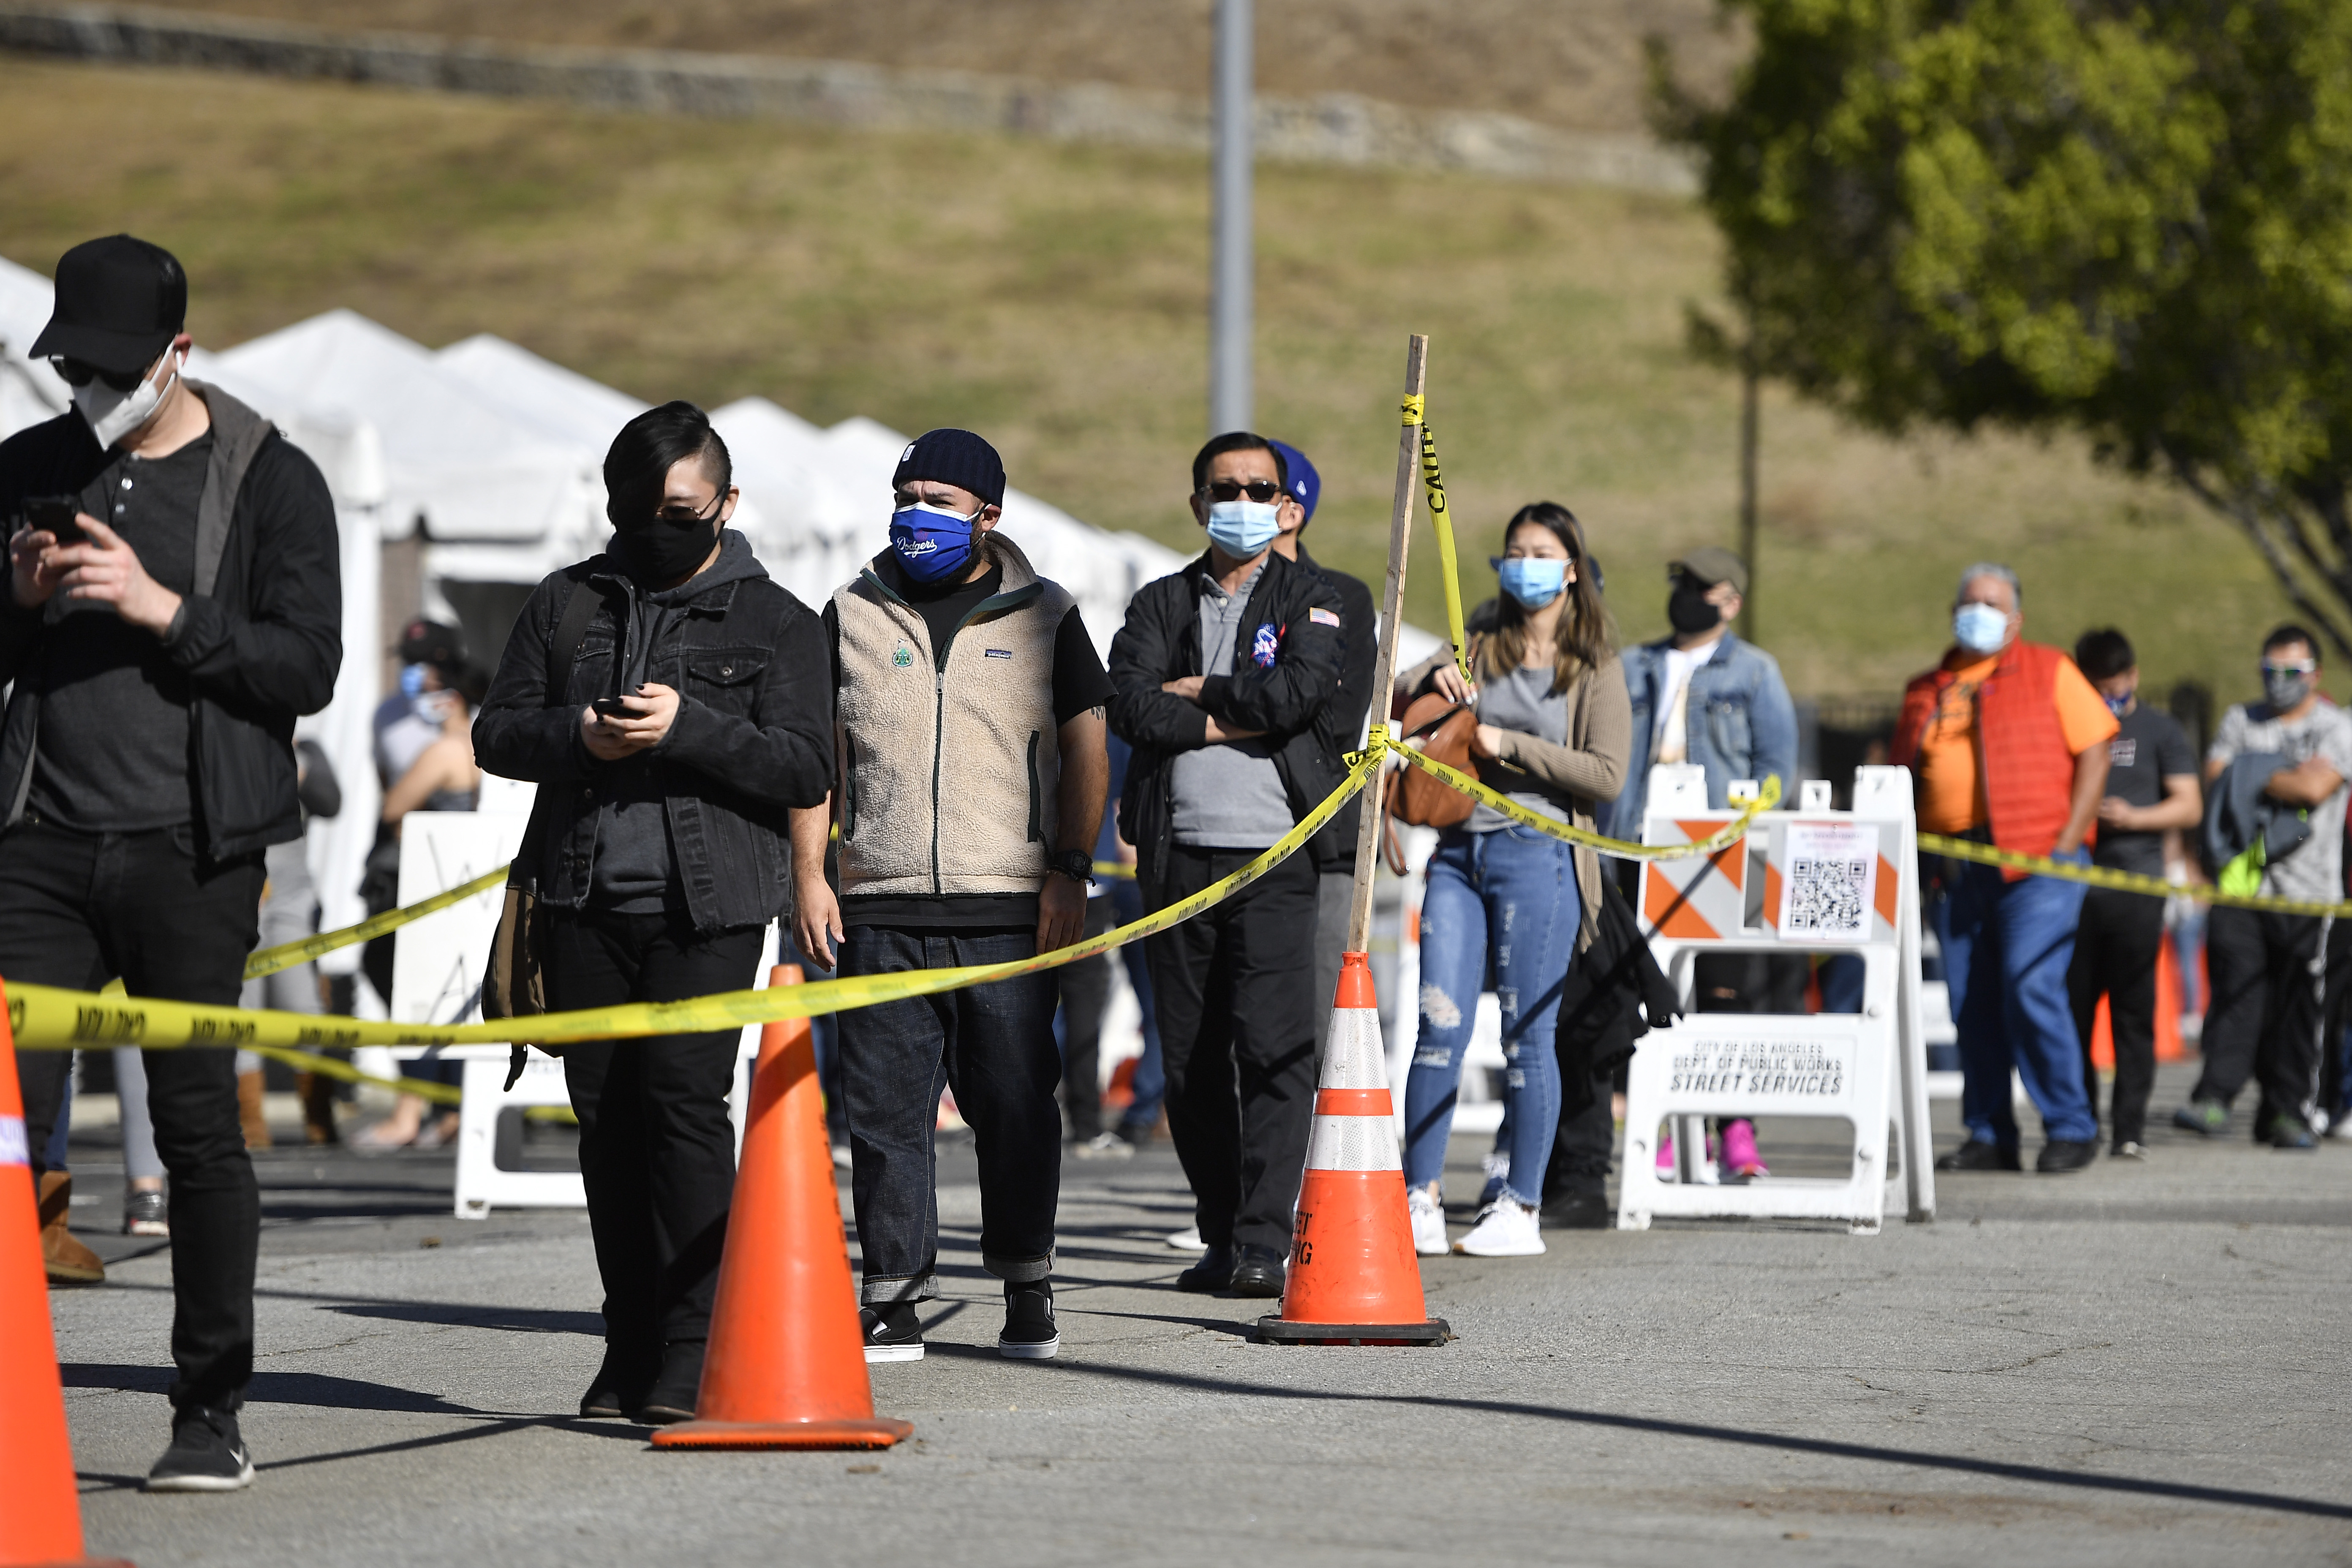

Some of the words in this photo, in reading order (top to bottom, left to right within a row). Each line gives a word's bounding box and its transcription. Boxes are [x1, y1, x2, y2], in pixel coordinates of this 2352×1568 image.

[897, 536, 937, 558] Dodgers
[1695, 1041, 1720, 1052] CITY
[1726, 1041, 1739, 1052] OF
[1744, 1042, 1765, 1053] LOS
[1771, 1042, 1824, 1054] ANGELES
[1718, 1056, 1733, 1069] OF
[1740, 1056, 1788, 1070] PUBLIC
[1794, 1057, 1843, 1070] WORKS
[1671, 1074, 1742, 1093] STREET
[1748, 1074, 1843, 1094] SERVICES
